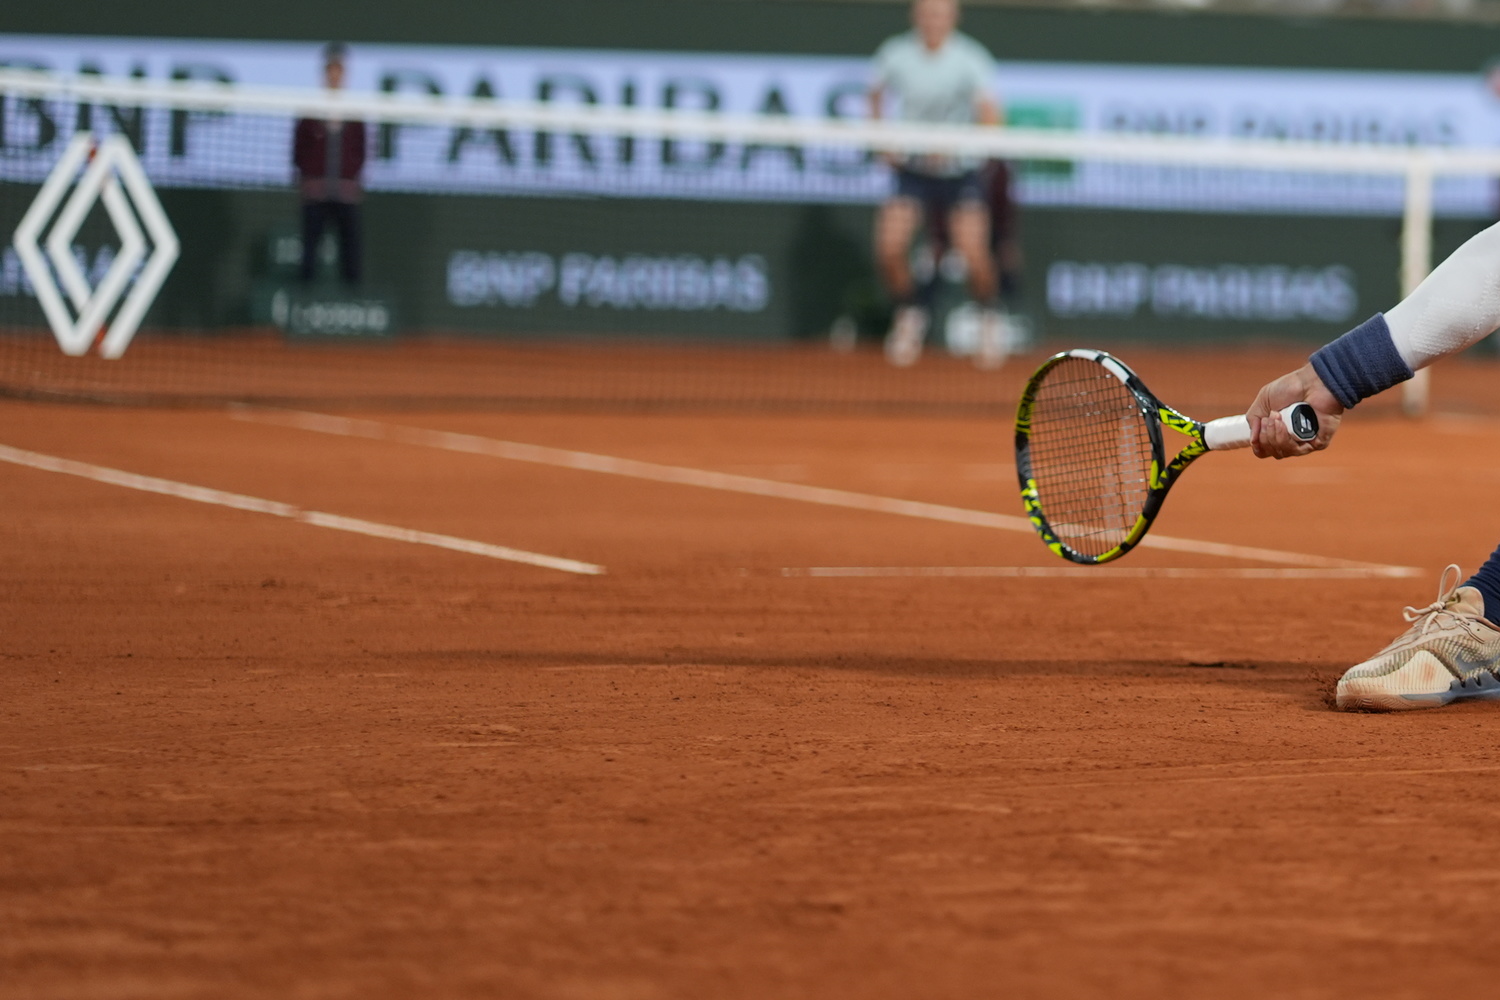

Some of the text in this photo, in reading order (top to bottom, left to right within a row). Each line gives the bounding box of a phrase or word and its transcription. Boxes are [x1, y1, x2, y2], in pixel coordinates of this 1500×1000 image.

[378, 66, 878, 176] PARIBAS
[448, 250, 769, 312] BNP PARIBAS
